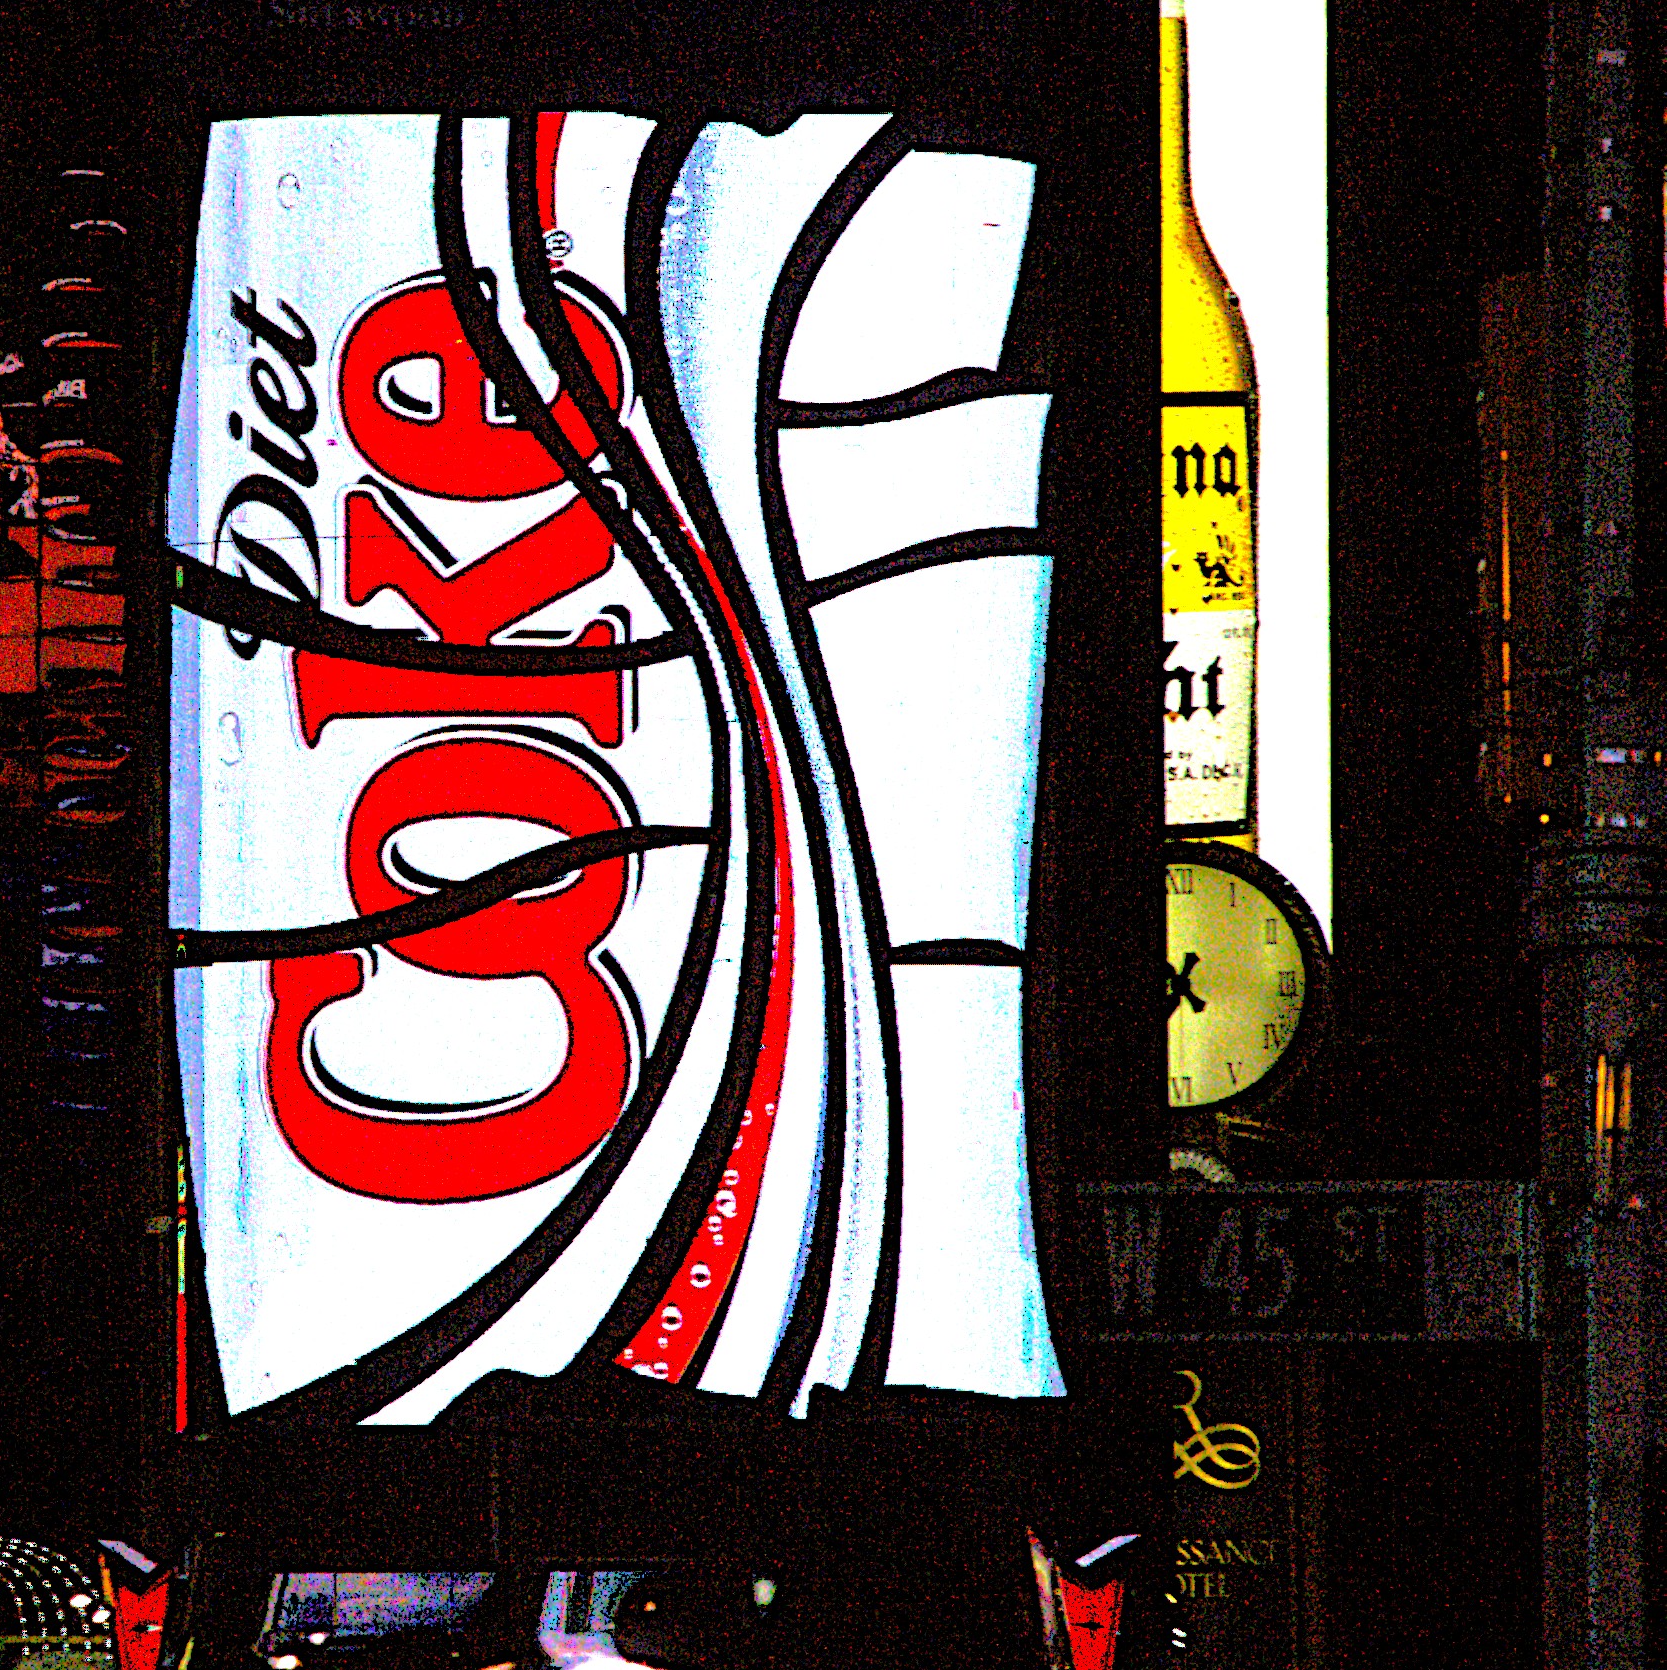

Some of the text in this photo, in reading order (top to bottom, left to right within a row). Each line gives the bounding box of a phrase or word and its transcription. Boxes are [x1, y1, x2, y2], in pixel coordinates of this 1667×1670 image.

[210, 285, 322, 662] Diet
[264, 270, 634, 1204] Coke
[1102, 1204, 1398, 1319] W 45 ST
